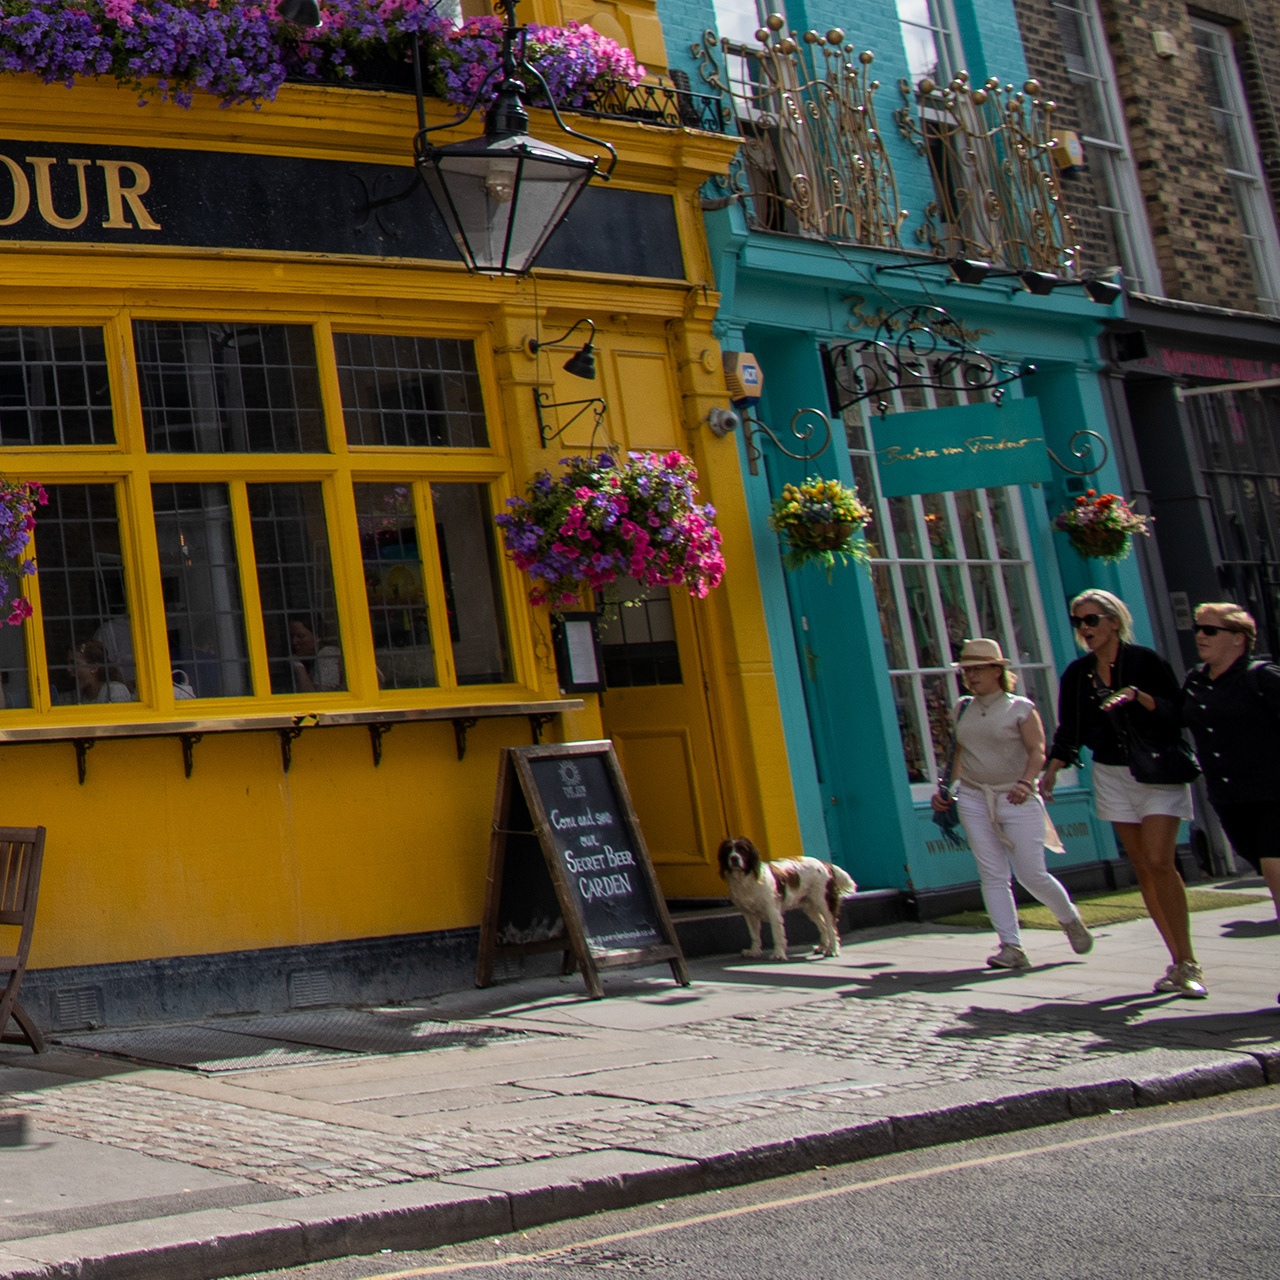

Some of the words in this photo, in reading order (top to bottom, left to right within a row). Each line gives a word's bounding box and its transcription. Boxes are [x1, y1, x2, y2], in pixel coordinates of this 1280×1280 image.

[550, 808, 577, 831] Come
[577, 807, 595, 827] and
[580, 834, 600, 848] our
[564, 849, 606, 874] SECRET
[604, 844, 637, 869] BEER
[578, 872, 633, 903] GARDEN
